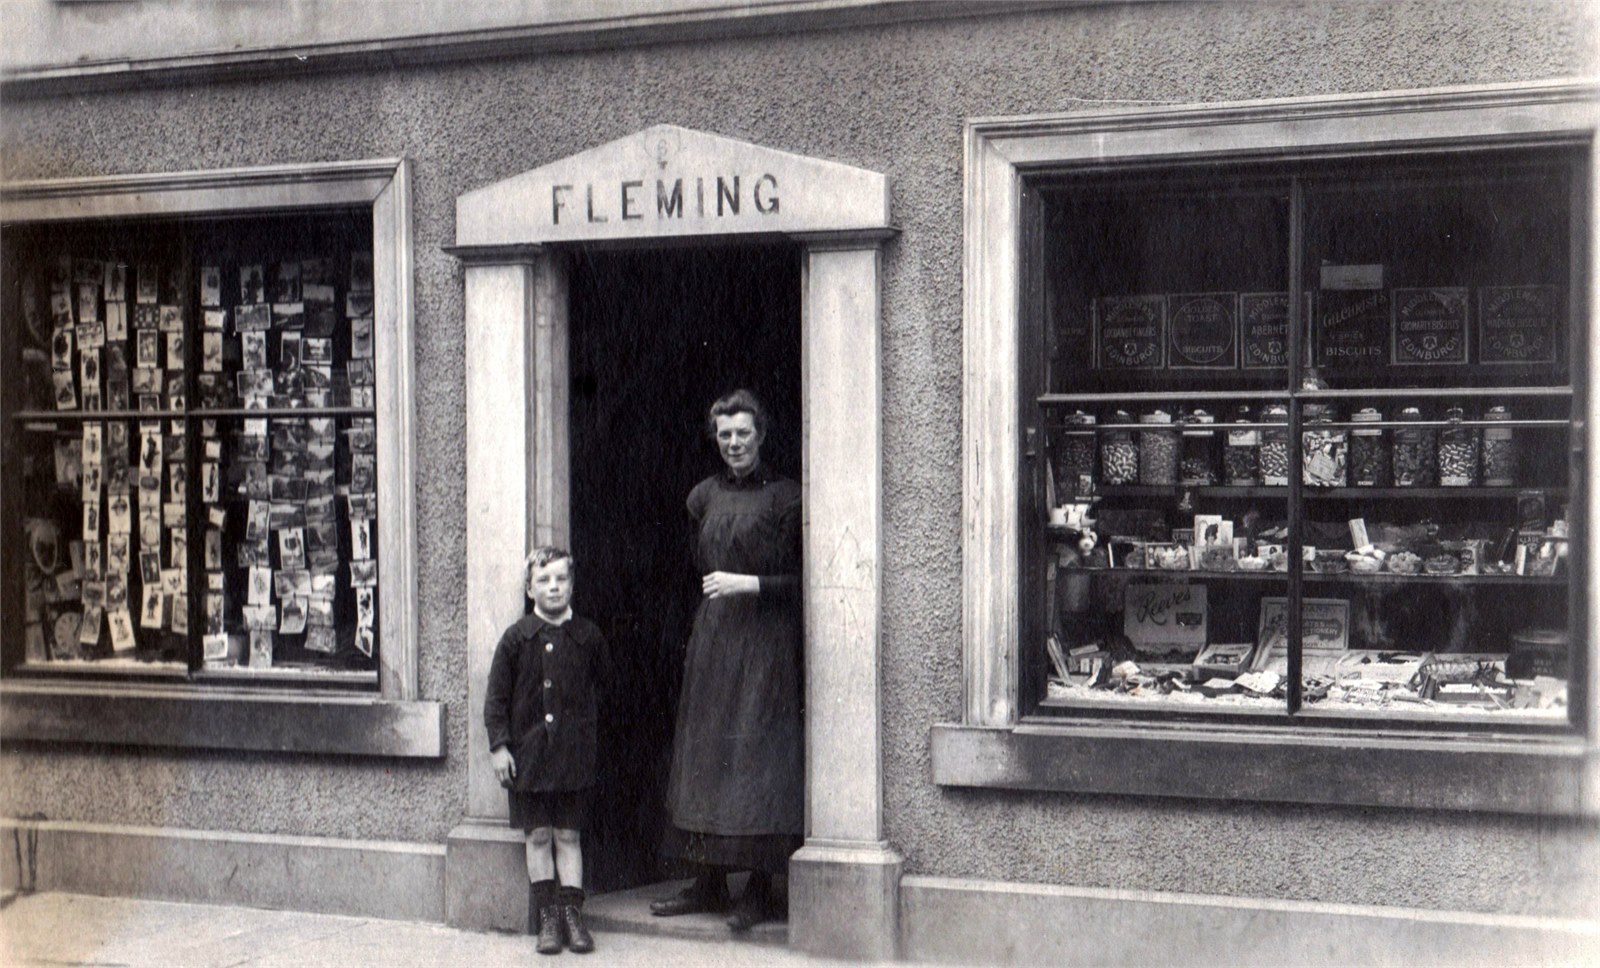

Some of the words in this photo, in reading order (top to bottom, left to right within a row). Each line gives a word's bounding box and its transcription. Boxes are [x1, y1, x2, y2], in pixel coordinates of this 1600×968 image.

[552, 173, 780, 225] FLEMING
[1187, 313, 1218, 323] TOAST
[1105, 342, 1156, 366] EDINBURGH
[1182, 345, 1224, 354] BISCUITS
[1325, 346, 1382, 357] BISCUITS
[1401, 336, 1459, 361] EDINBURGH
[1488, 334, 1545, 358] EDINBURGH
[1136, 588, 1191, 626] Reeves
